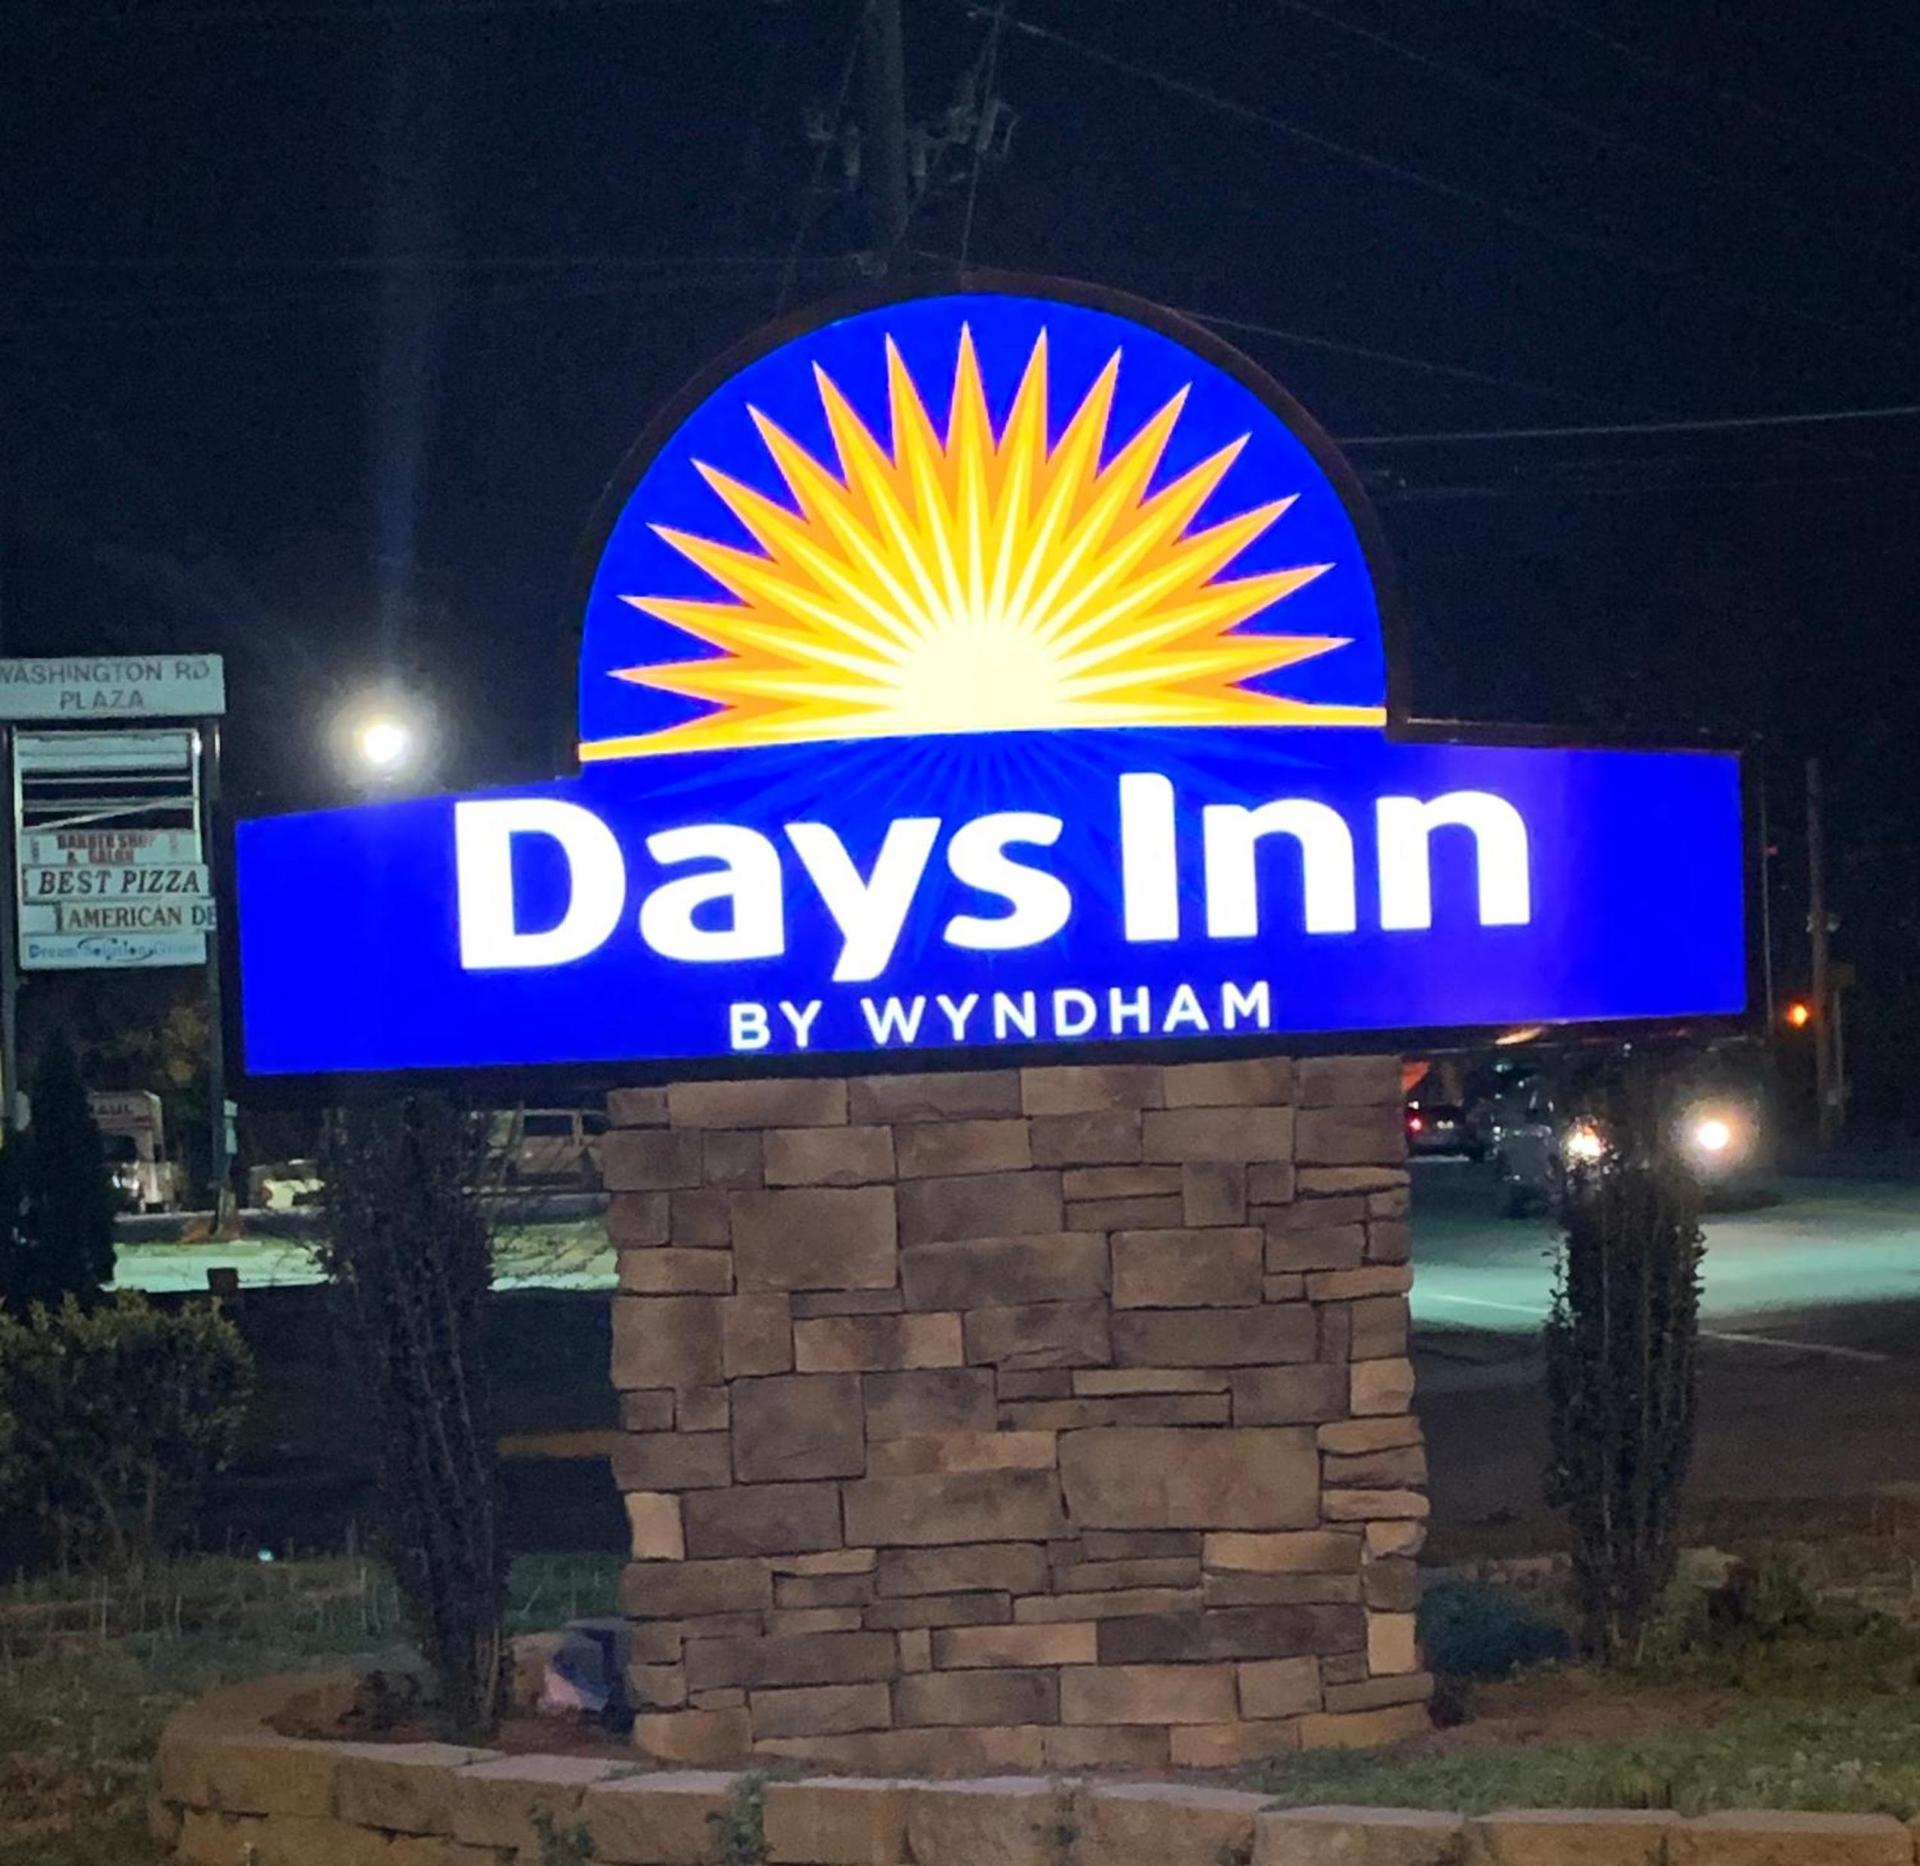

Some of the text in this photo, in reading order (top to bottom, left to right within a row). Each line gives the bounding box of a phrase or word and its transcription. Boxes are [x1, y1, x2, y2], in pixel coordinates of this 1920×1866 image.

[174, 661, 210, 680] RD
[59, 689, 145, 710] PLAZA
[38, 870, 200, 895] BEST PIZZA
[453, 771, 1532, 983] Days Inn
[68, 906, 182, 928] AMERICAN
[729, 981, 1271, 1050] BY WYNDHAM
